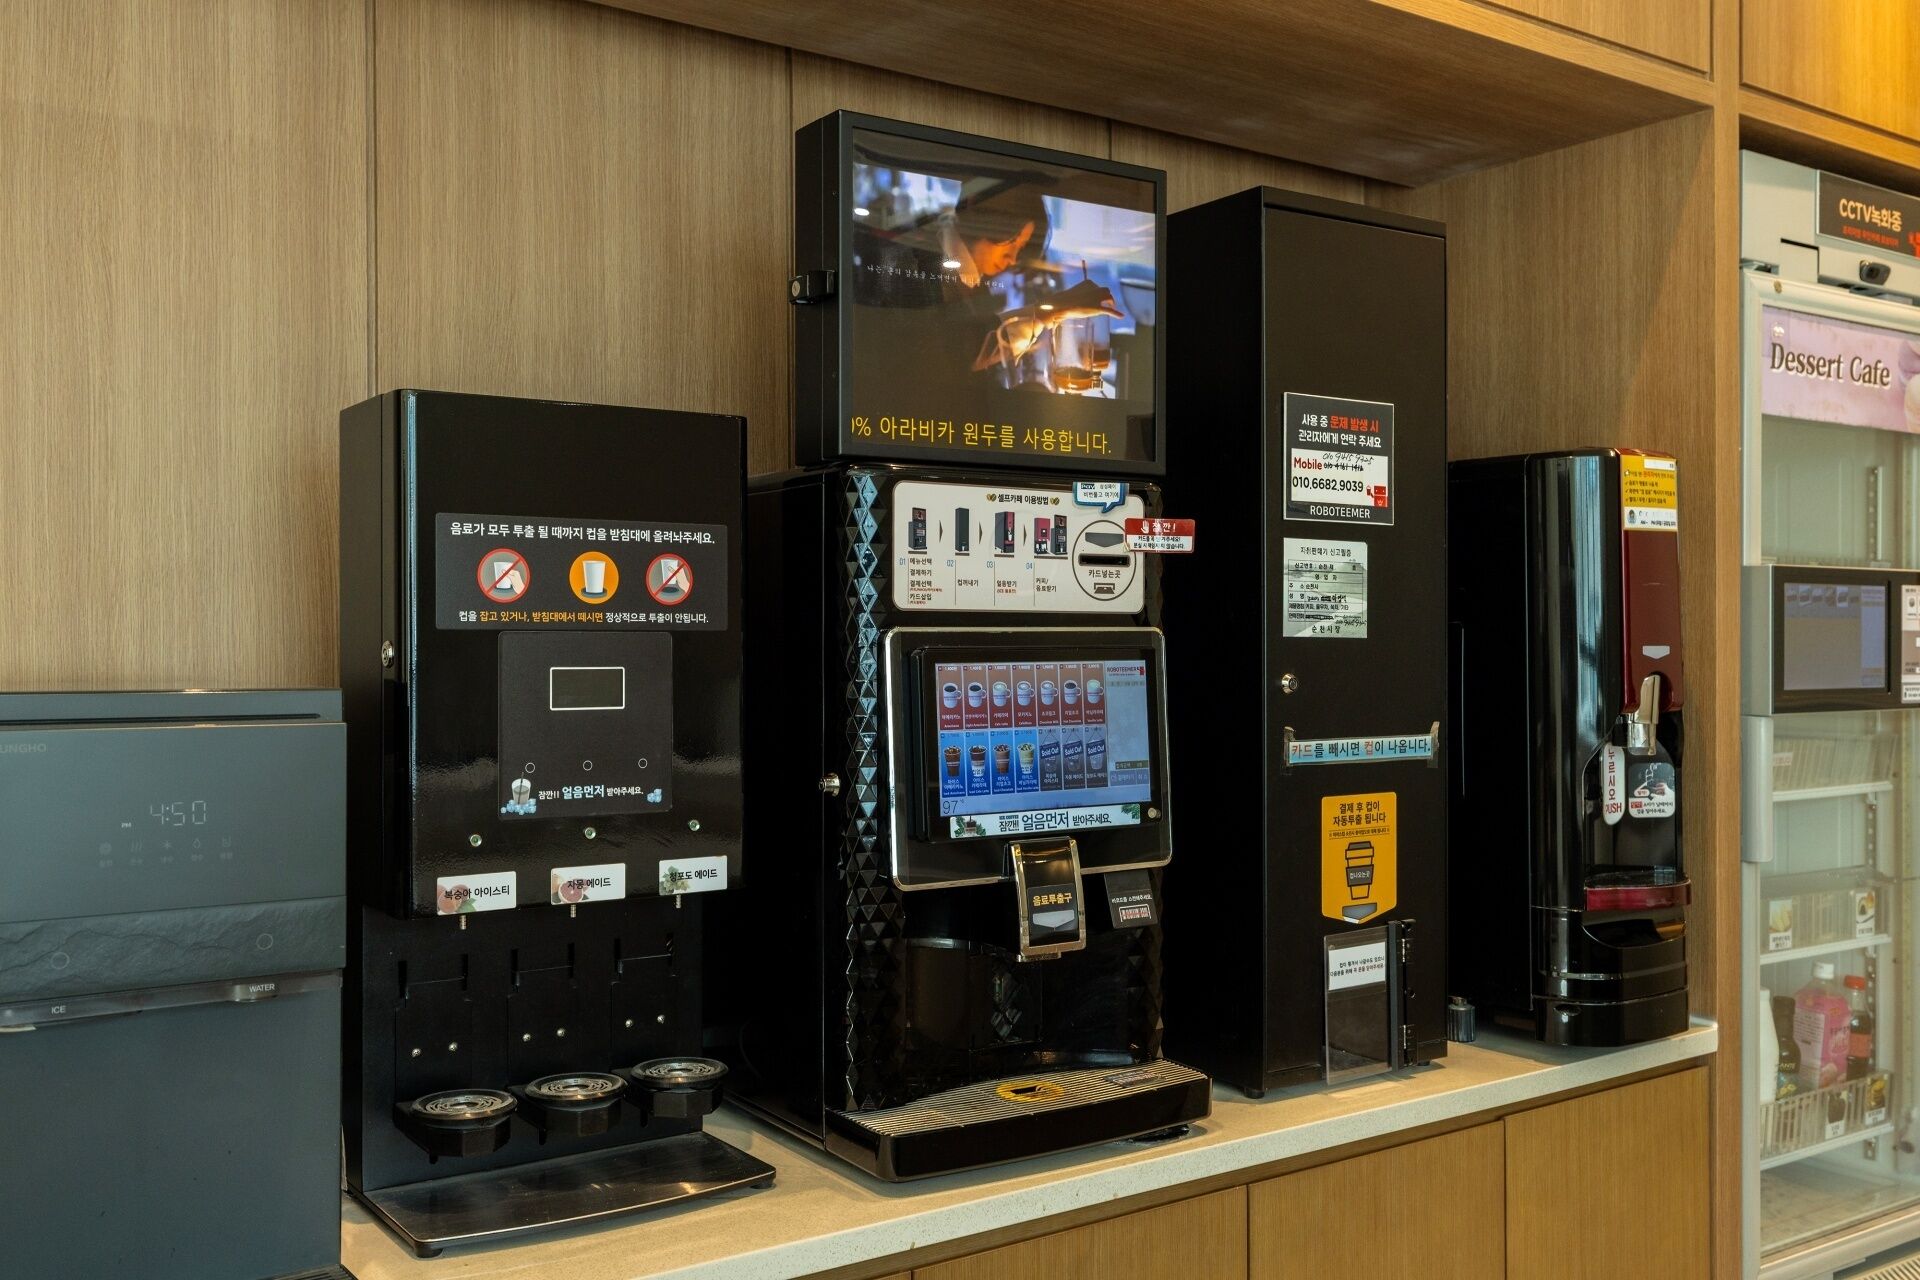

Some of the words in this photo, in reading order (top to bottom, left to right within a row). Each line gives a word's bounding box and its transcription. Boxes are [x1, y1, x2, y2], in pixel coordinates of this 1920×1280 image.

[1840, 199, 1902, 232] CCTV녹화중
[1770, 342, 1843, 379] Dessert
[1850, 357, 1890, 386] Cafe
[1302, 414, 1318, 427] 사용
[1320, 416, 1328, 427] 중
[1330, 416, 1348, 429] 문제
[1350, 418, 1368, 433] 발생
[1370, 420, 1379, 433] 시
[880, 416, 955, 444] 아라비카
[962, 422, 1015, 448] 원두를
[1023, 427, 1112, 455] 사용합니다.
[1298, 430, 1338, 444] 관리자에게
[1340, 433, 1357, 446] 연락
[1359, 435, 1381, 448] 주세요
[1294, 457, 1322, 470] Mobile
[1293, 476, 1363, 492] 010.6682.9039
[997, 494, 1022, 504] 셀프카페
[1024, 495, 1048, 505] 이용방법
[1310, 505, 1370, 518] ROBOTEEMER
[450, 522, 485, 536] 음료가
[487, 523, 510, 537] 모두
[513, 525, 535, 538] 투출
[537, 525, 549, 539] 될
[551, 526, 583, 540] 때까지
[586, 527, 607, 541] 컵을
[609, 529, 650, 542] 받침대에
[652, 530, 715, 545] 올려놔주세요.
[1089, 570, 1121, 579] 카드넣는곳
[458, 610, 477, 622] 컵을
[479, 611, 498, 622] 잡고
[500, 611, 530, 623] 있거나,
[532, 611, 576, 622] 받침대에서
[578, 612, 603, 622] 떼시면
[605, 612, 647, 623] 정상적으로
[649, 612, 673, 623] 투출이
[675, 612, 709, 624] 안됩니다.
[1292, 743, 1324, 759] 카드를
[1329, 742, 1360, 757] 빼시면
[1364, 741, 1384, 755] 컵이
[1388, 738, 1430, 753] 나옵니다.
[1608, 749, 1616, 800] 누르시오
[562, 784, 605, 799] 얼음먼저
[606, 786, 644, 796] 받아주세요.
[150, 800, 206, 826] 4:50
[943, 800, 958, 814] 97
[1340, 803, 1354, 814] 결제
[1356, 802, 1363, 812] 후
[1366, 801, 1380, 812] 컵이
[1022, 811, 1069, 831] 얼음먼저
[1333, 814, 1363, 827] 자동투출
[1365, 812, 1386, 824] 됩니다
[669, 869, 693, 881] 청포도
[694, 868, 718, 879] 에이드
[567, 879, 584, 890] 자몽
[586, 877, 612, 888] 에이드
[444, 888, 472, 900] 복숭아
[474, 884, 510, 898] 아이스티
[1032, 892, 1072, 906] 음료투출구
[249, 983, 275, 993] WATER
[51, 1005, 67, 1014] ICE
